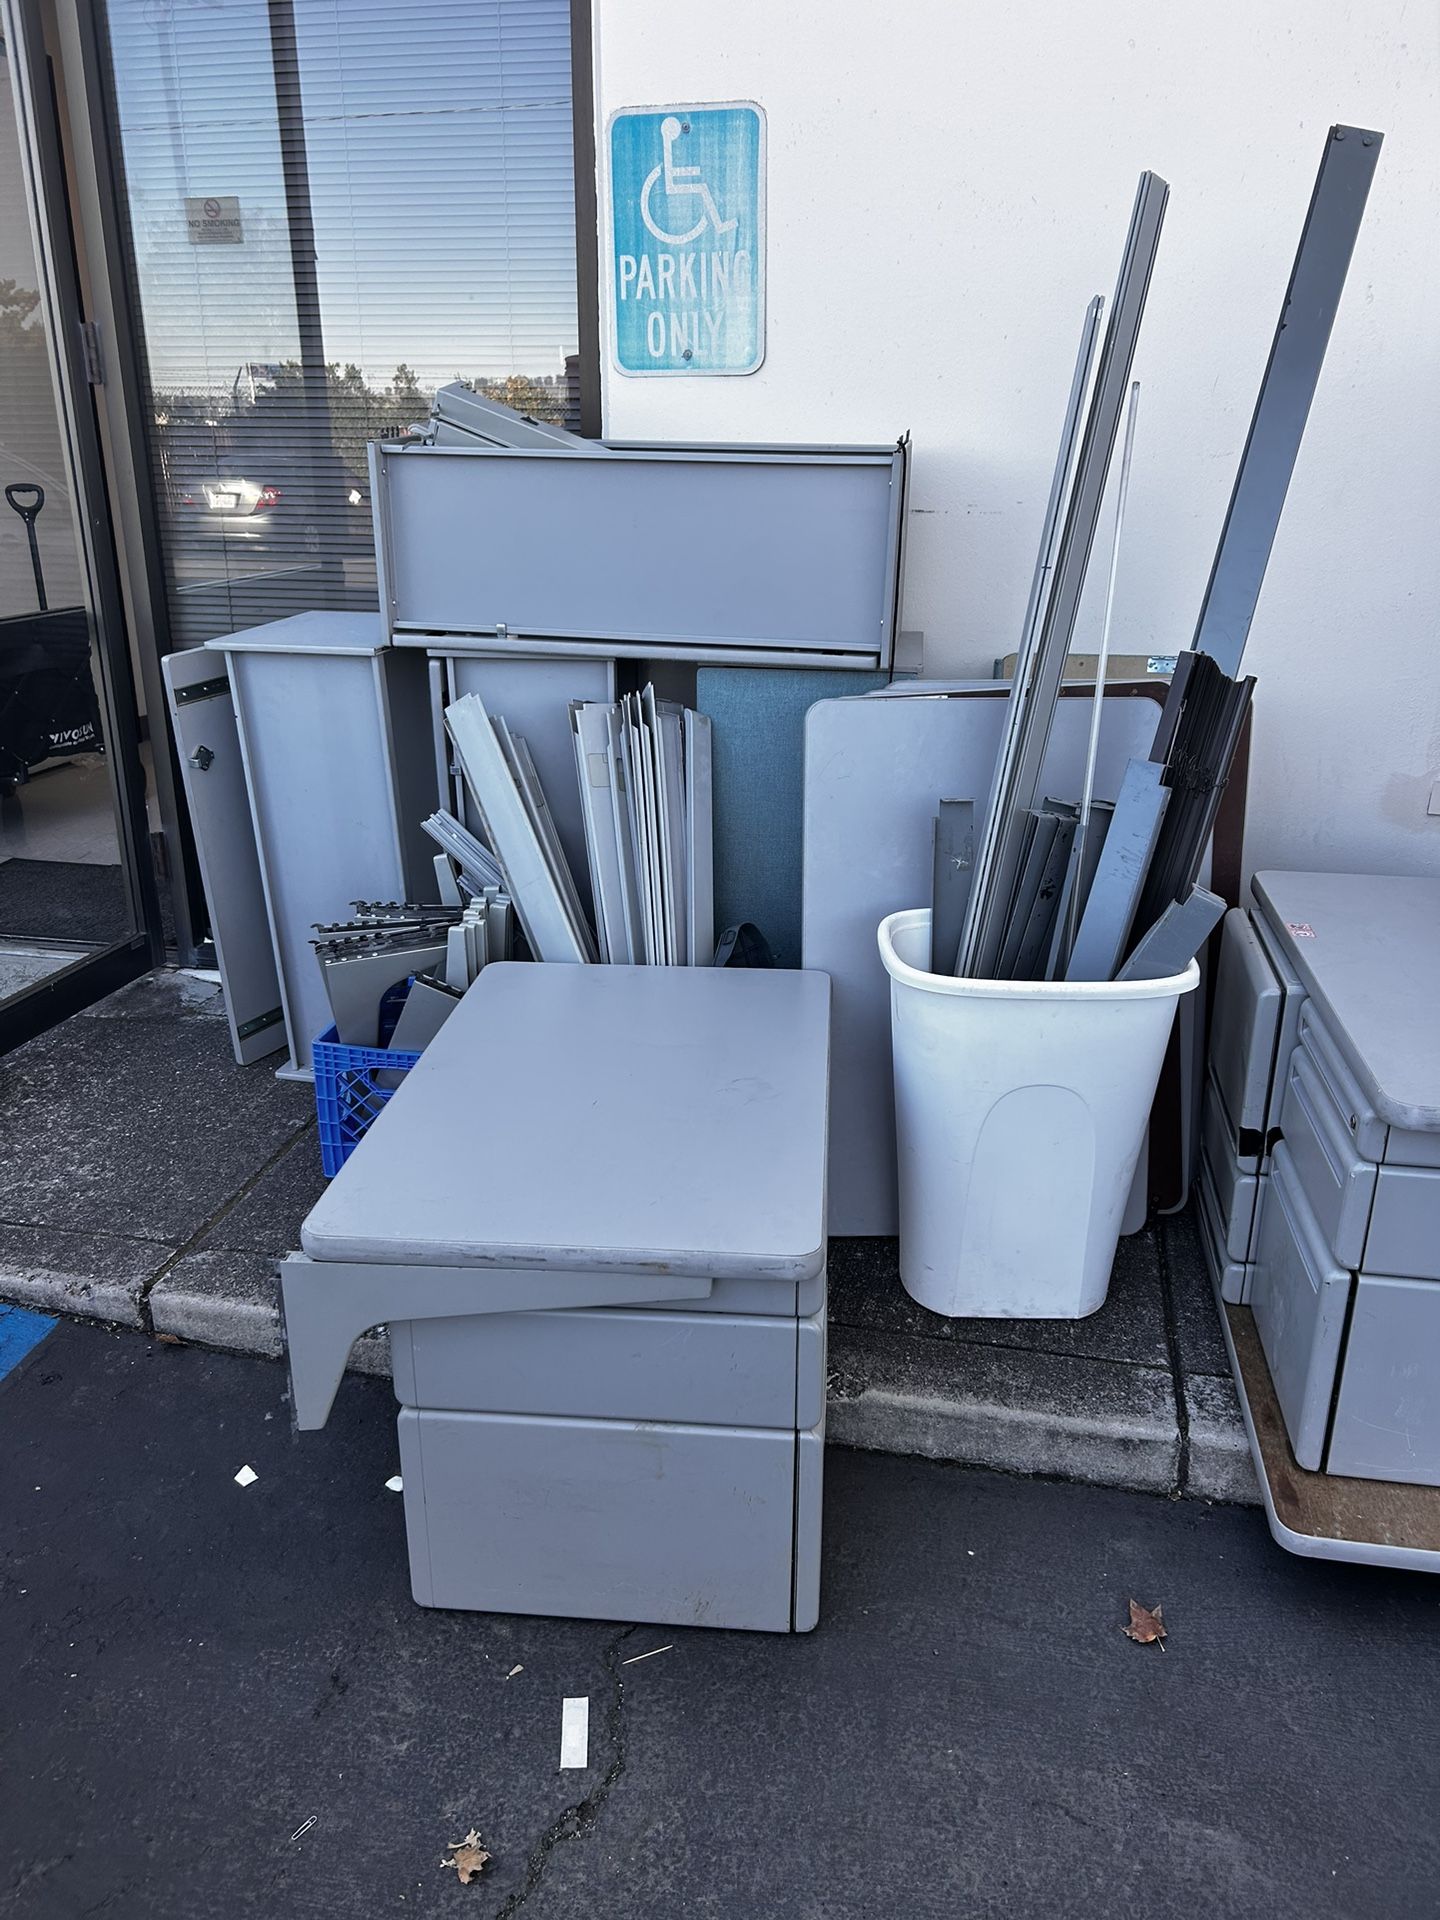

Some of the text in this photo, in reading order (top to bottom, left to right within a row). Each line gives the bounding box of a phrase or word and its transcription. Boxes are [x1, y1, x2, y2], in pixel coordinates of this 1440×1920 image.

[188, 218, 241, 228] NO SMOKING
[620, 250, 752, 300] PARKING
[647, 311, 726, 357] ONLY
[49, 721, 94, 744] VIVOSUN
